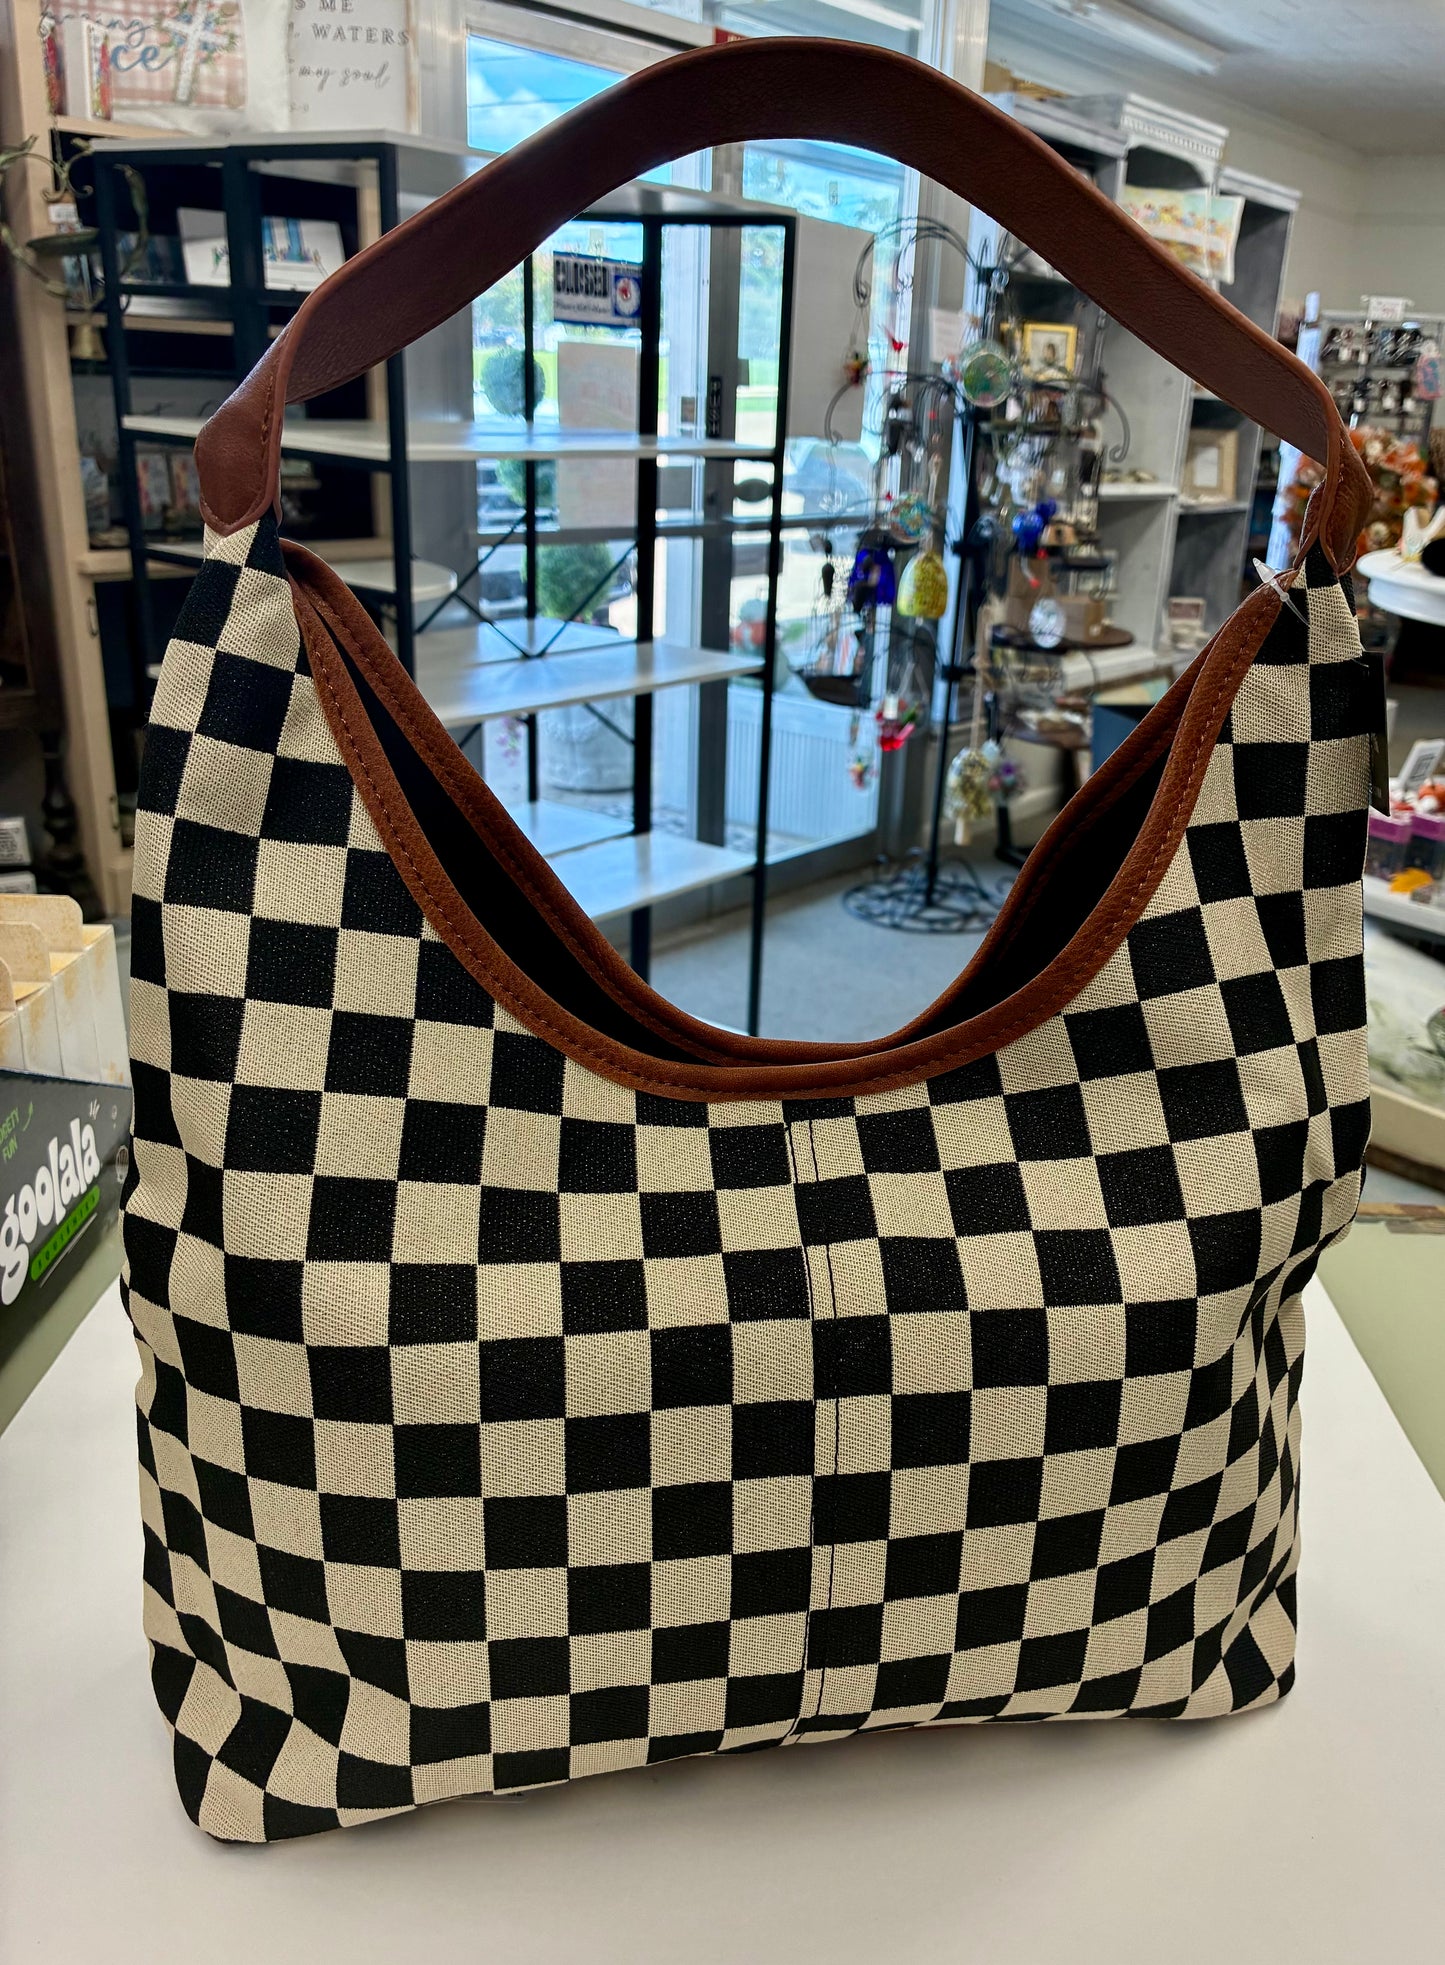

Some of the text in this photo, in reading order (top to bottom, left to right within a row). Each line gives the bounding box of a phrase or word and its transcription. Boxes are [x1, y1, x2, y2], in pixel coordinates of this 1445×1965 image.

[320, 0, 354, 13] ME
[311, 22, 409, 46] WATERS
[339, 61, 390, 89] soul
[555, 260, 609, 298] CLOSED
[2, 1134, 18, 1164] FUN
[0, 1117, 100, 1305] goolala
